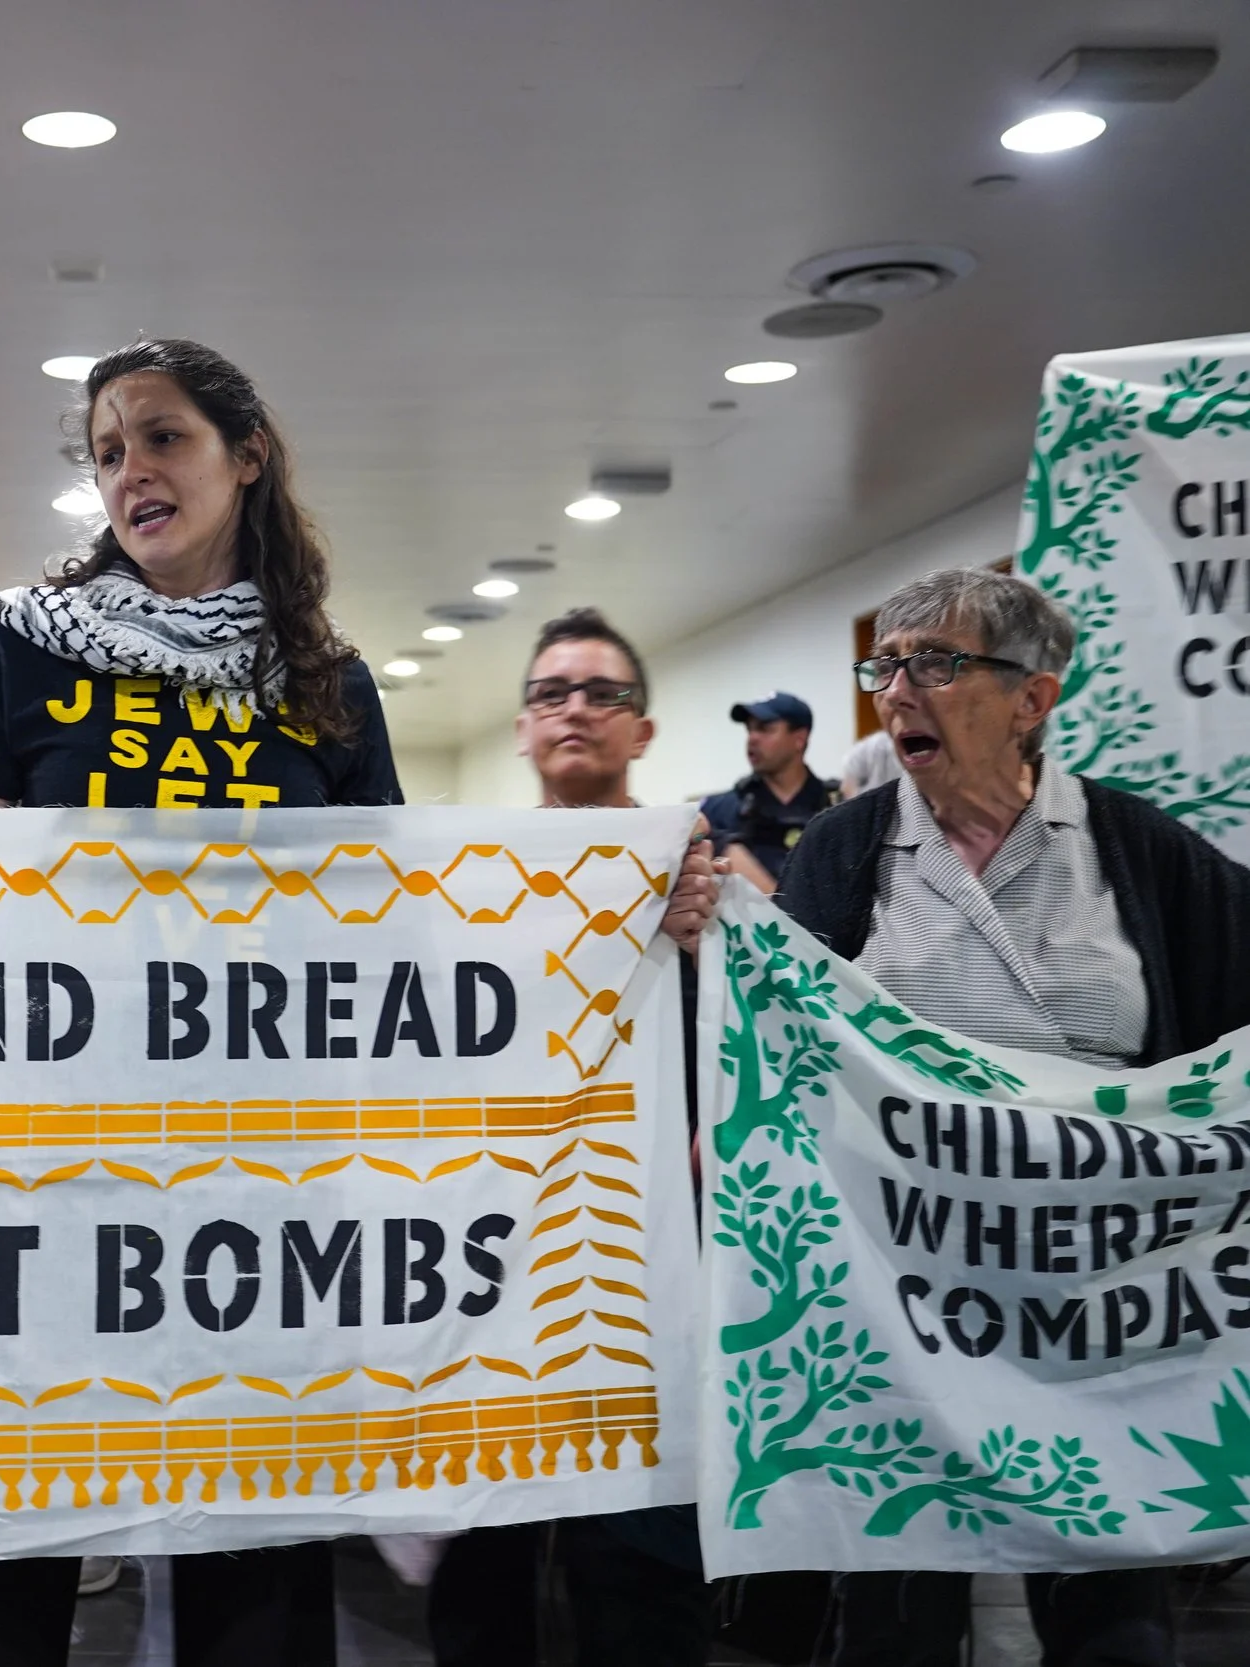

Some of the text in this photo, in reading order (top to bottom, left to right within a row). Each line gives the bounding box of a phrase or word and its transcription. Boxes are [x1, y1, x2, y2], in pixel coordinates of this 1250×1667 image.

[1174, 558, 1250, 616] W
[109, 729, 261, 777] SAY
[147, 960, 517, 1061] BREAD
[879, 1177, 1200, 1273] WHERE
[96, 1214, 516, 1334] BOMBS
